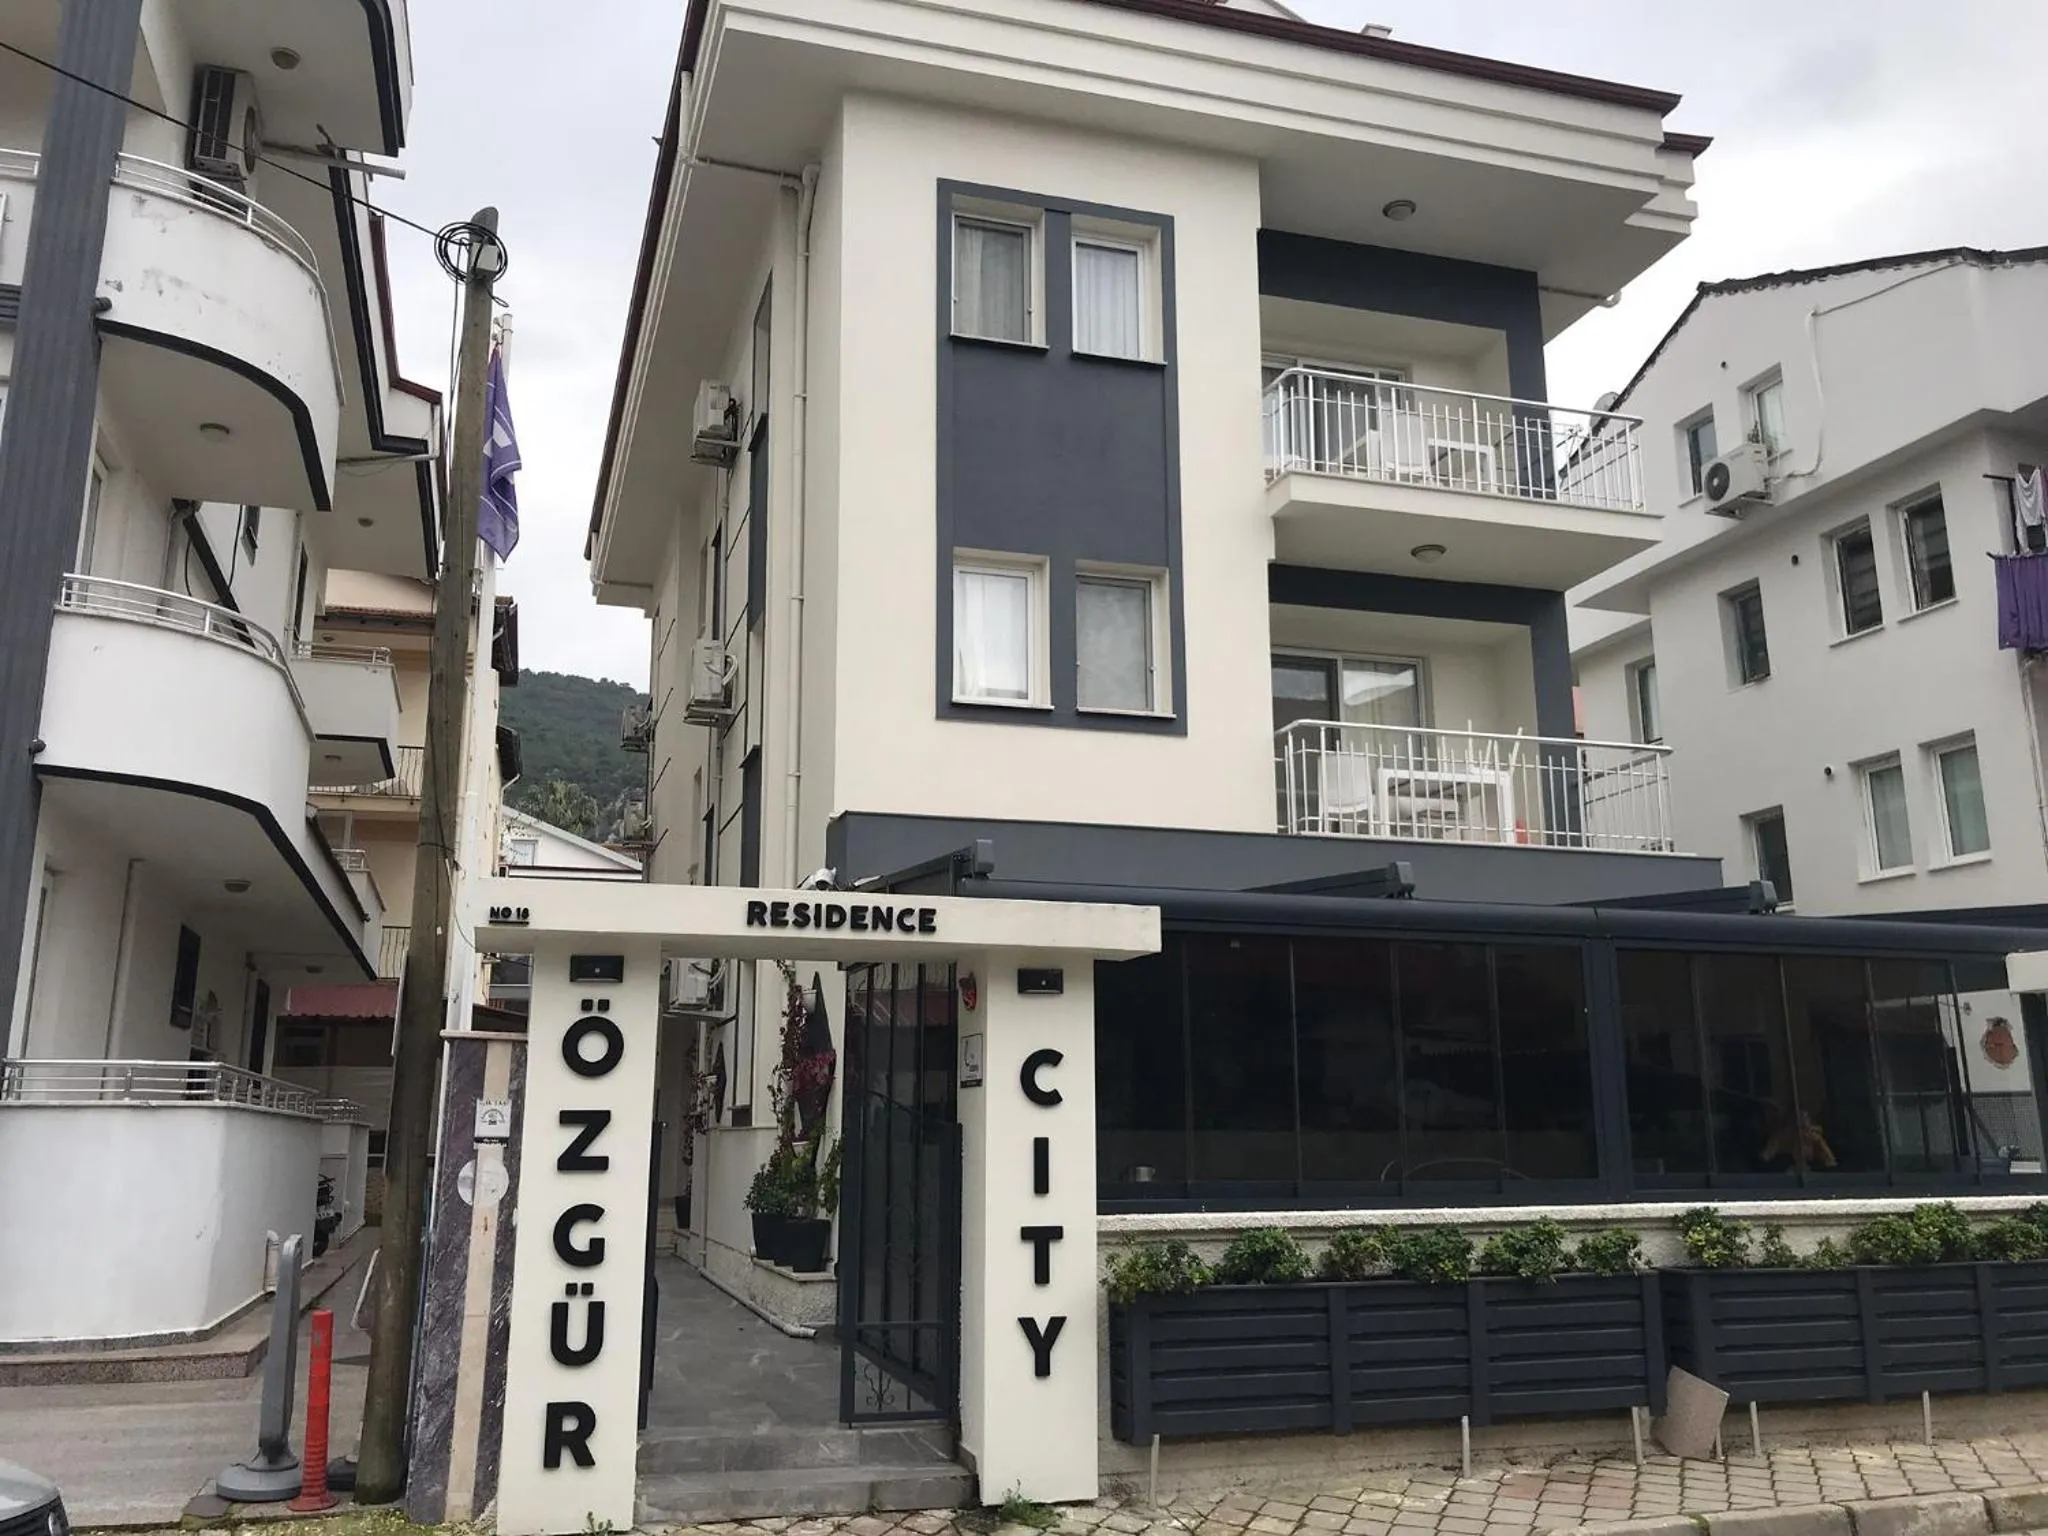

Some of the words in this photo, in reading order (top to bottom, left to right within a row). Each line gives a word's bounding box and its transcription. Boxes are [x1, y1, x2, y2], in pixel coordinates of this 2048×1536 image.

[490, 906, 512, 919] NO
[746, 900, 937, 935] RESIDENCE
[543, 998, 625, 1470] ÖZGÜR
[1017, 1048, 1067, 1379] CITY
